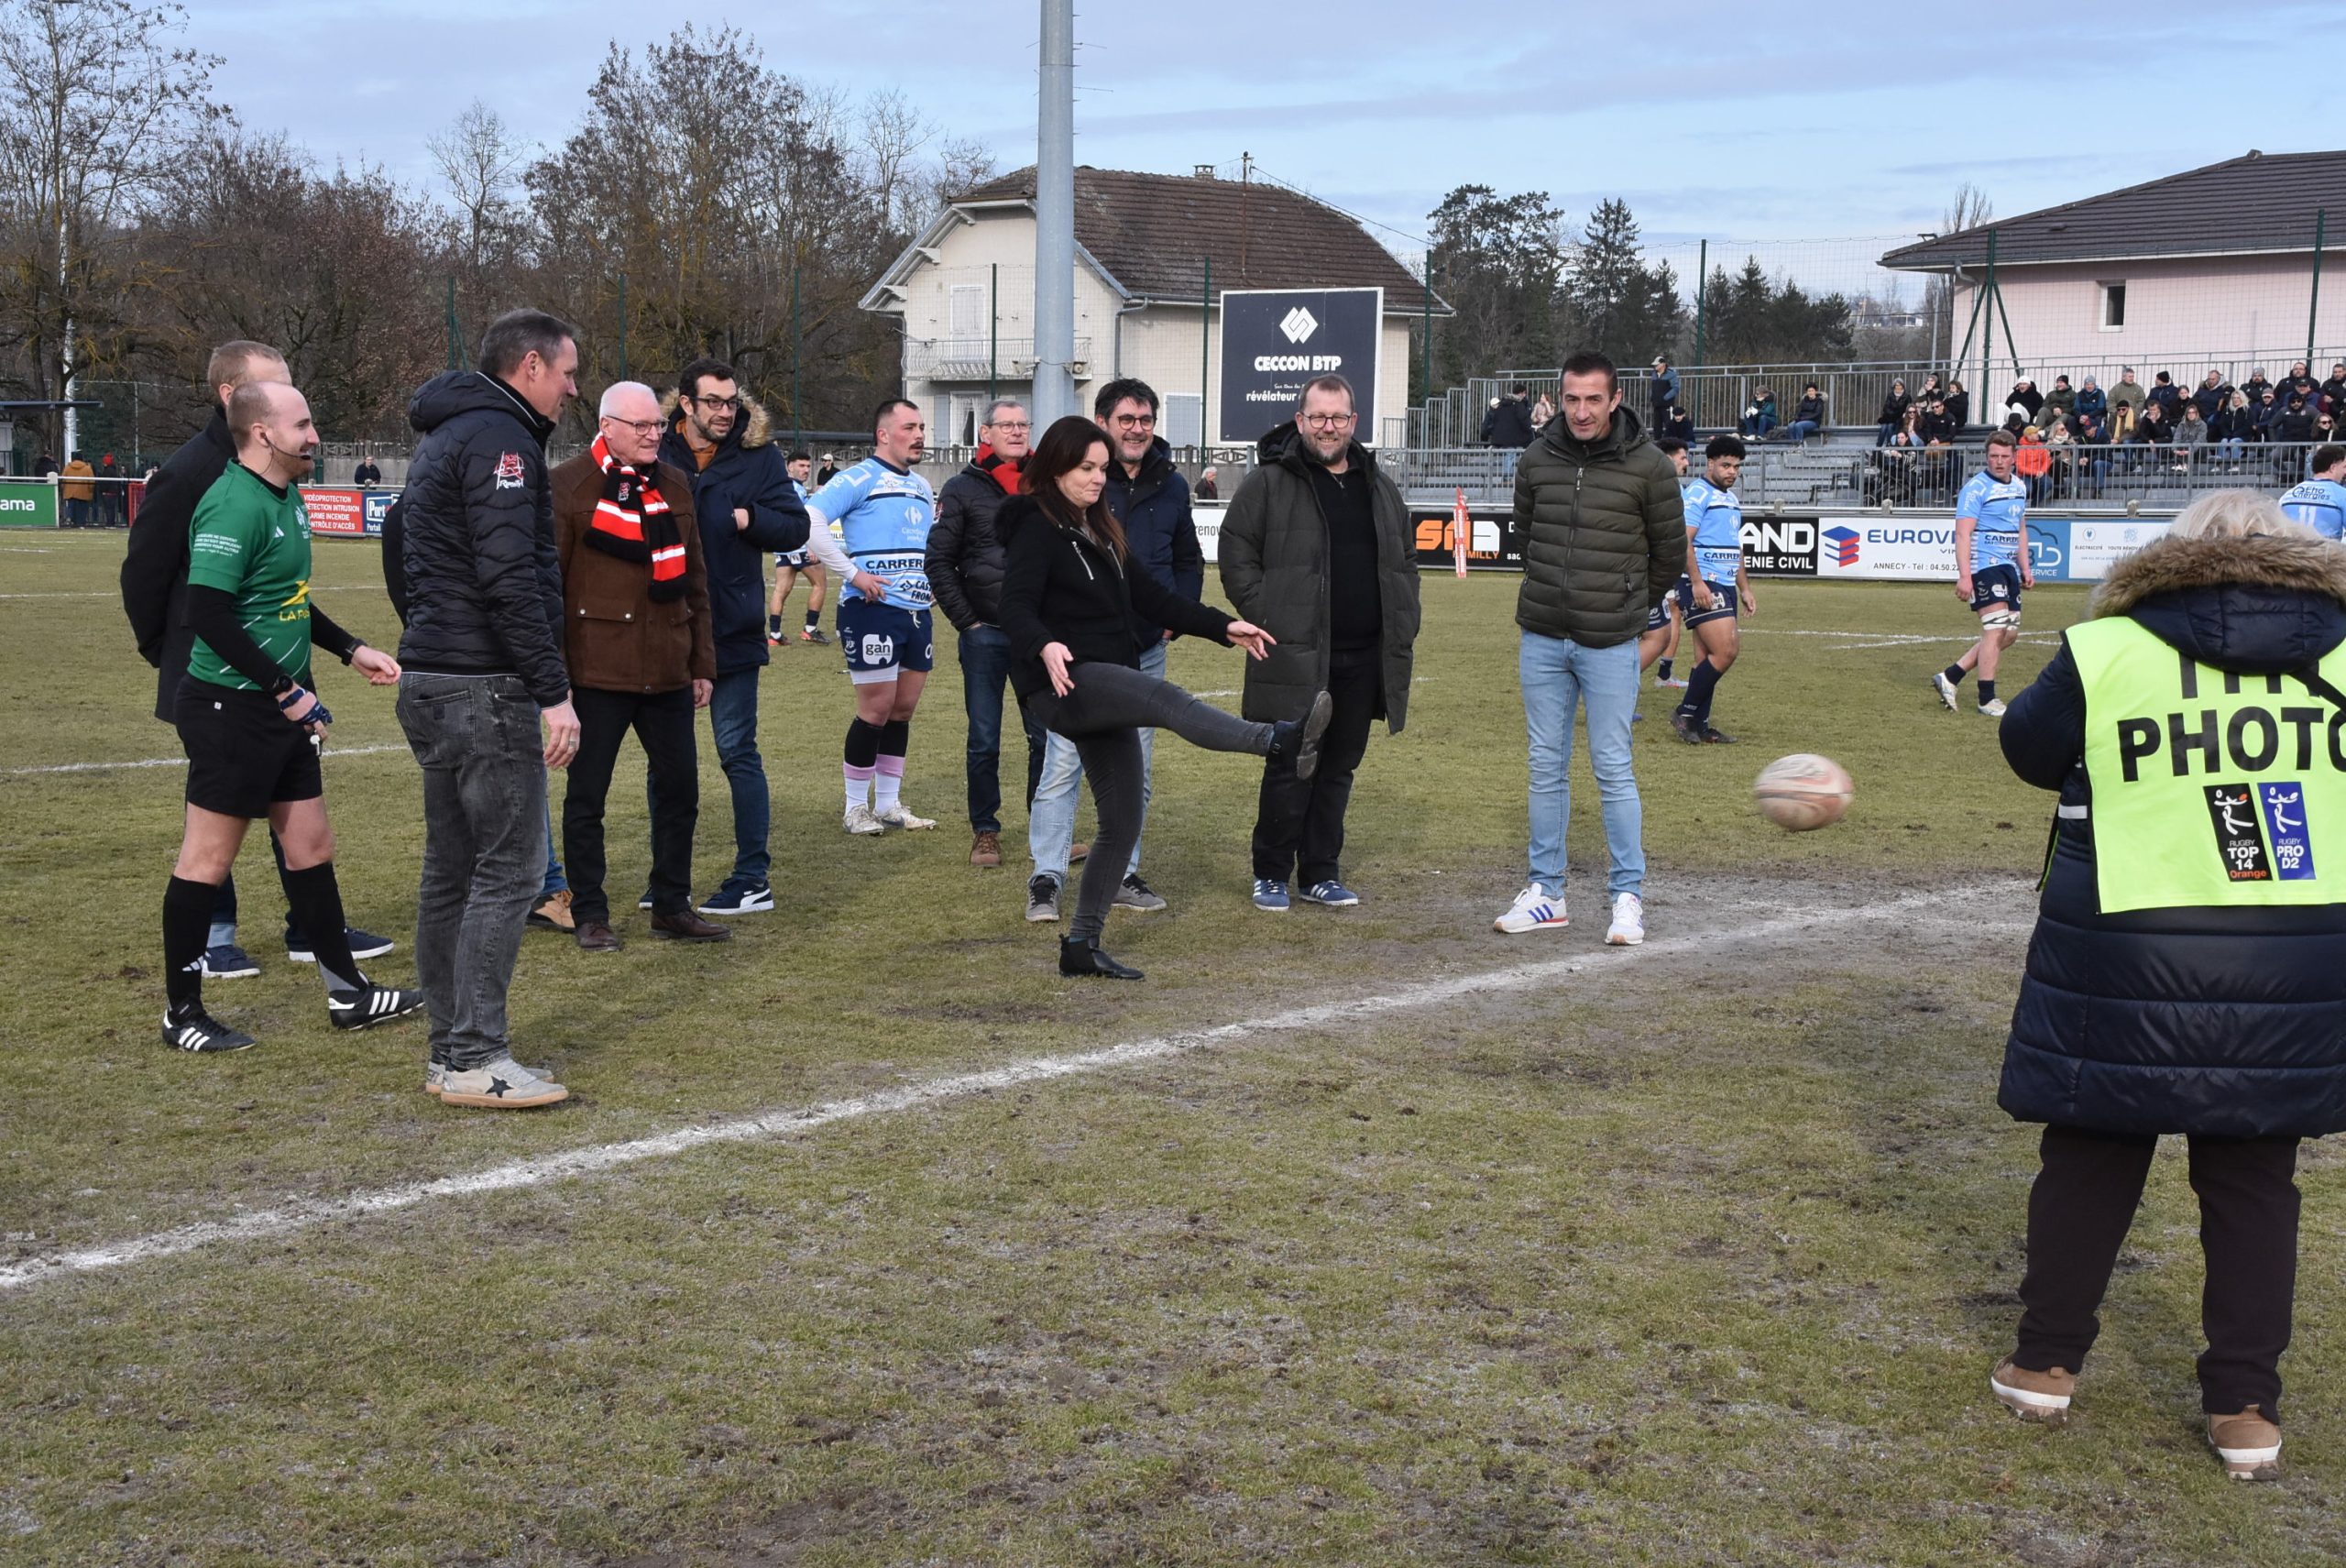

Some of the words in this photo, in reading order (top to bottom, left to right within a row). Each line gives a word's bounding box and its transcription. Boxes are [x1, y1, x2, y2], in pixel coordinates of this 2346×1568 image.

[1254, 356, 1310, 371] CECCON
[1312, 356, 1342, 371] BTP
[1246, 390, 1297, 401] révélateur
[304, 494, 352, 503] VIDÉOPROTECTION
[0, 499, 36, 510] ama
[333, 504, 360, 512] INTRUSION
[368, 500, 389, 518] Port
[865, 558, 923, 569] CARRER
[1744, 555, 1774, 568] ENIE
[1778, 556, 1814, 569] CIVIL
[2028, 568, 2057, 576] ERVICE
[278, 610, 296, 621] LA
[865, 643, 891, 656] gan
[2229, 839, 2255, 847] RUGBY
[2278, 838, 2302, 846] RUGBY
[2227, 846, 2260, 860] TOP
[2276, 845, 2305, 858] PRO
[2235, 858, 2254, 871] 14
[2281, 858, 2300, 870] D2
[2230, 870, 2267, 879] Orange
